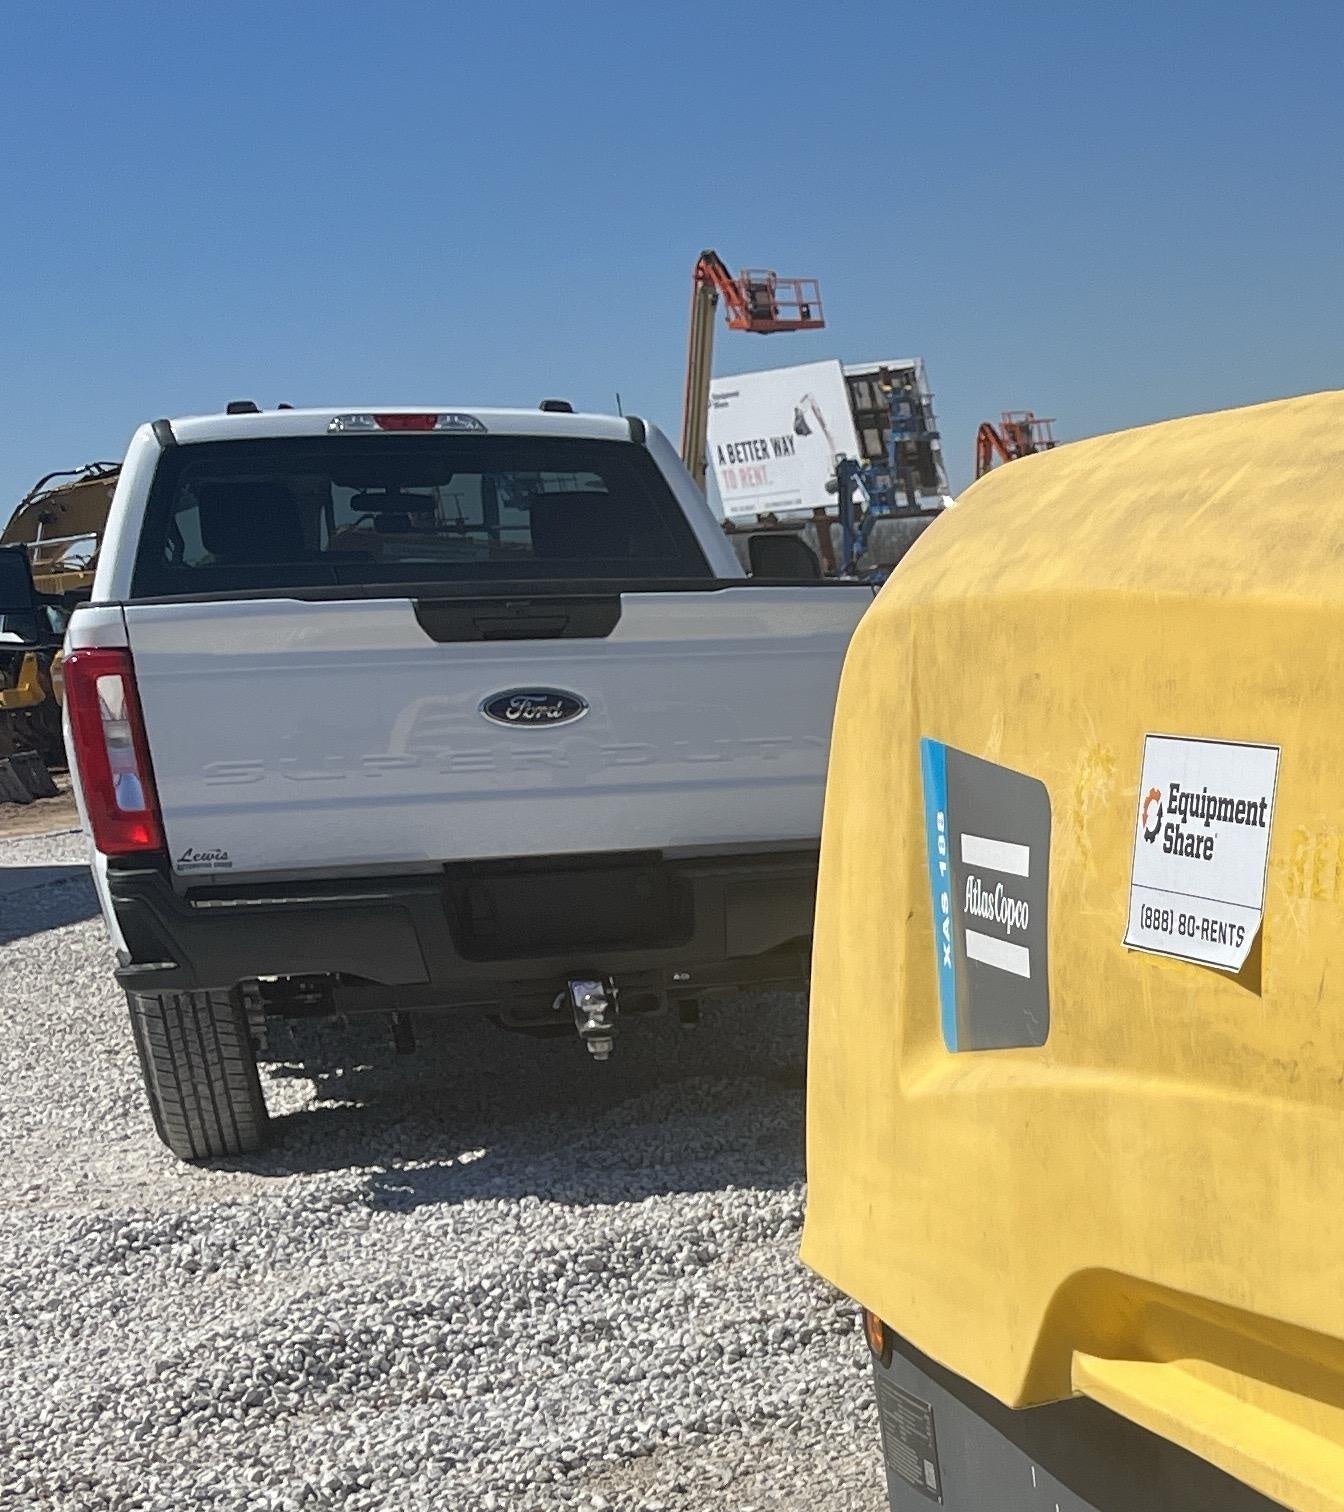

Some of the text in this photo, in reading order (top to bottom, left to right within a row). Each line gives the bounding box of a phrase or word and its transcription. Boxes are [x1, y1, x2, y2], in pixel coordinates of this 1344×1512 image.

[717, 434, 796, 465] A BETTER WAY
[504, 696, 565, 721] Ford
[203, 745, 570, 787] SUPER
[1166, 782, 1268, 828] Equipment
[1162, 822, 1215, 861] Share
[940, 891, 952, 969] XAS
[1140, 903, 1246, 948] (888) 80-RENTS
